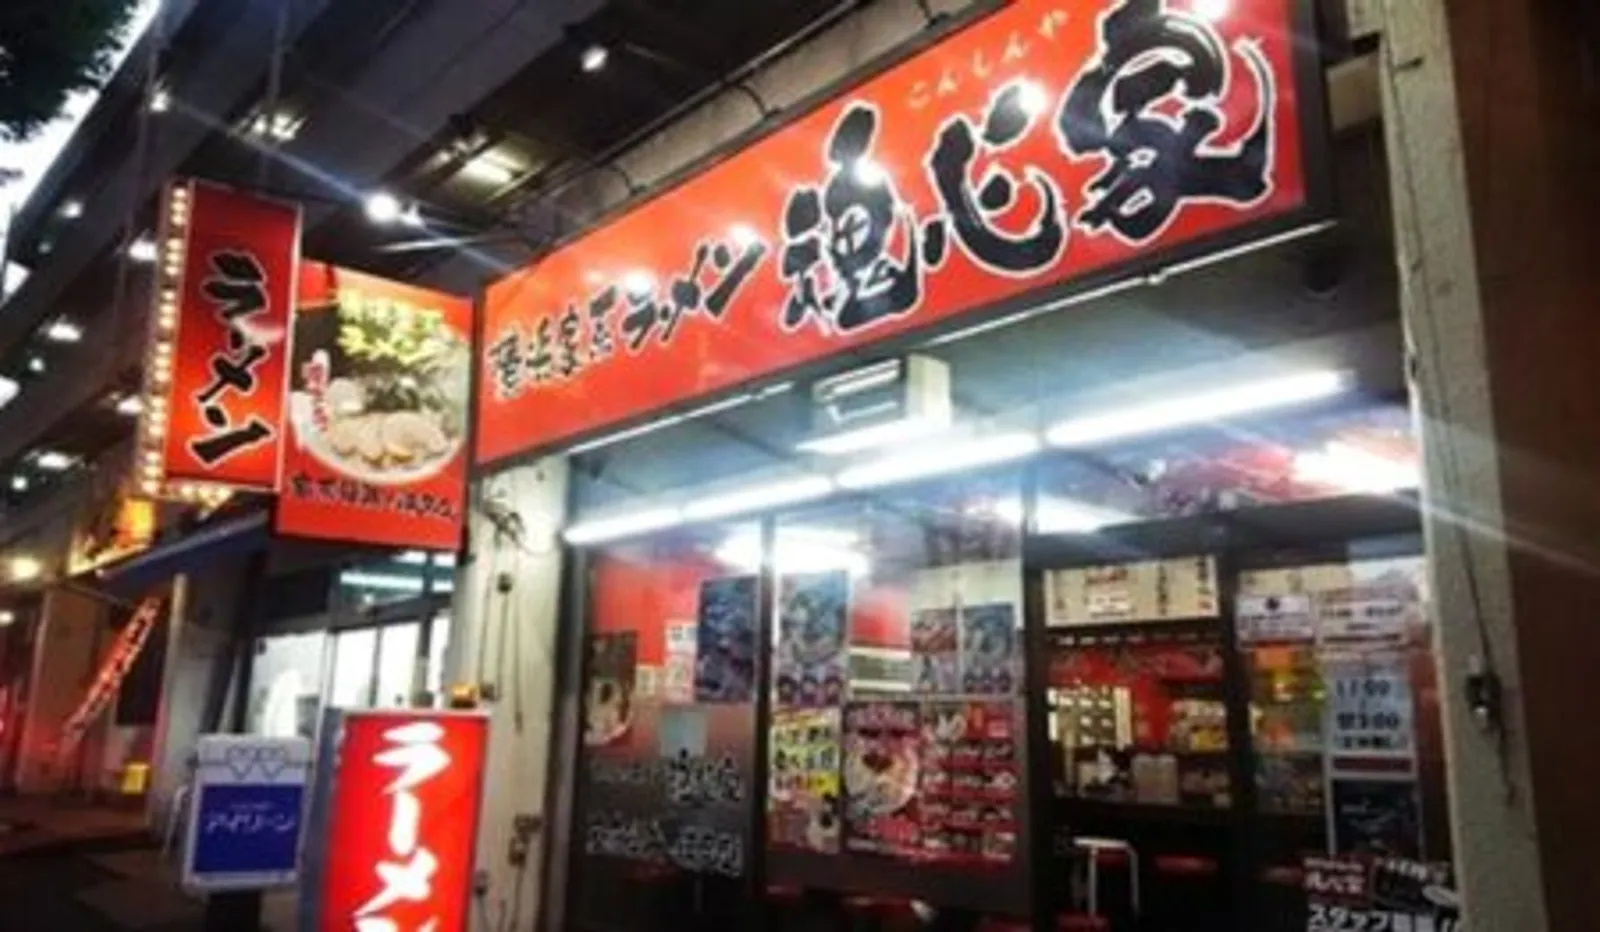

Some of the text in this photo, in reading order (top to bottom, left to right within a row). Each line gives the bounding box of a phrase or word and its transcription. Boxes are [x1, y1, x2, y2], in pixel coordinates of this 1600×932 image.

[190, 252, 271, 463] ラーメン
[353, 721, 451, 932] ラーメ
